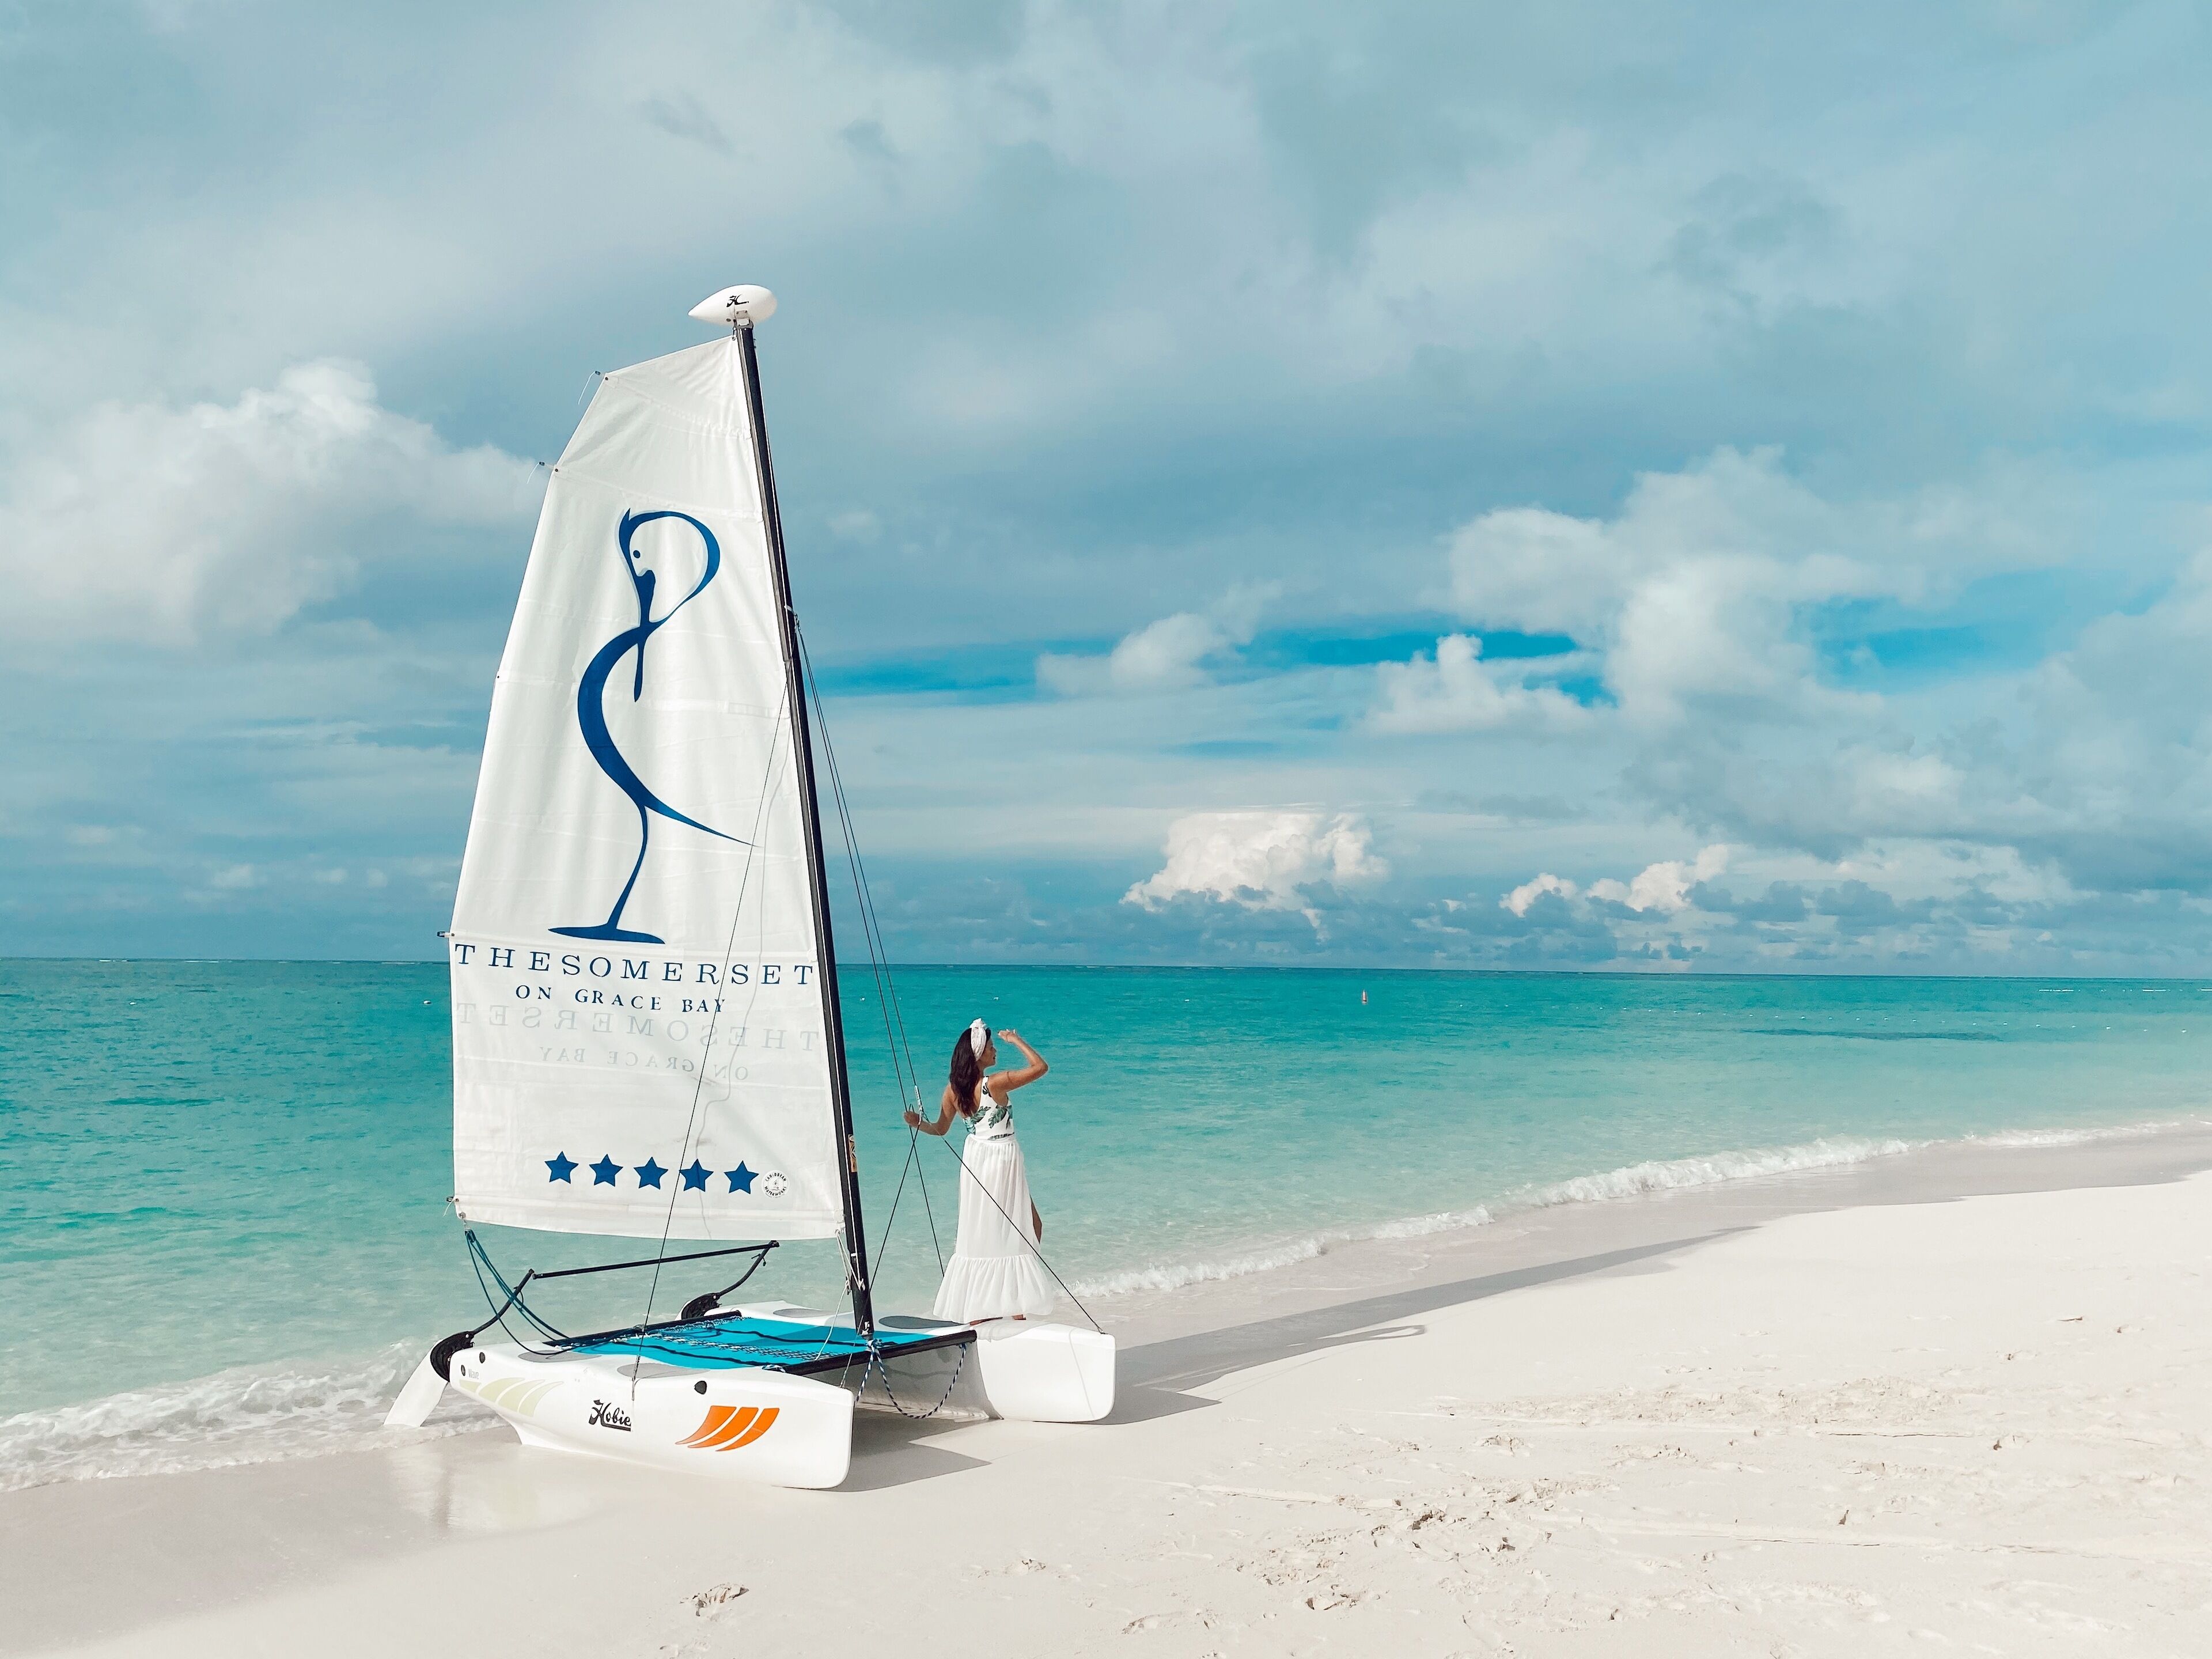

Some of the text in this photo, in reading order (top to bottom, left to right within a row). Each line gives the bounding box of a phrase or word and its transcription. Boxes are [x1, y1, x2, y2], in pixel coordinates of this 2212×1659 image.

[516, 984, 725, 1013] ON GRACE BAY
[588, 1399, 631, 1431] Hobie
